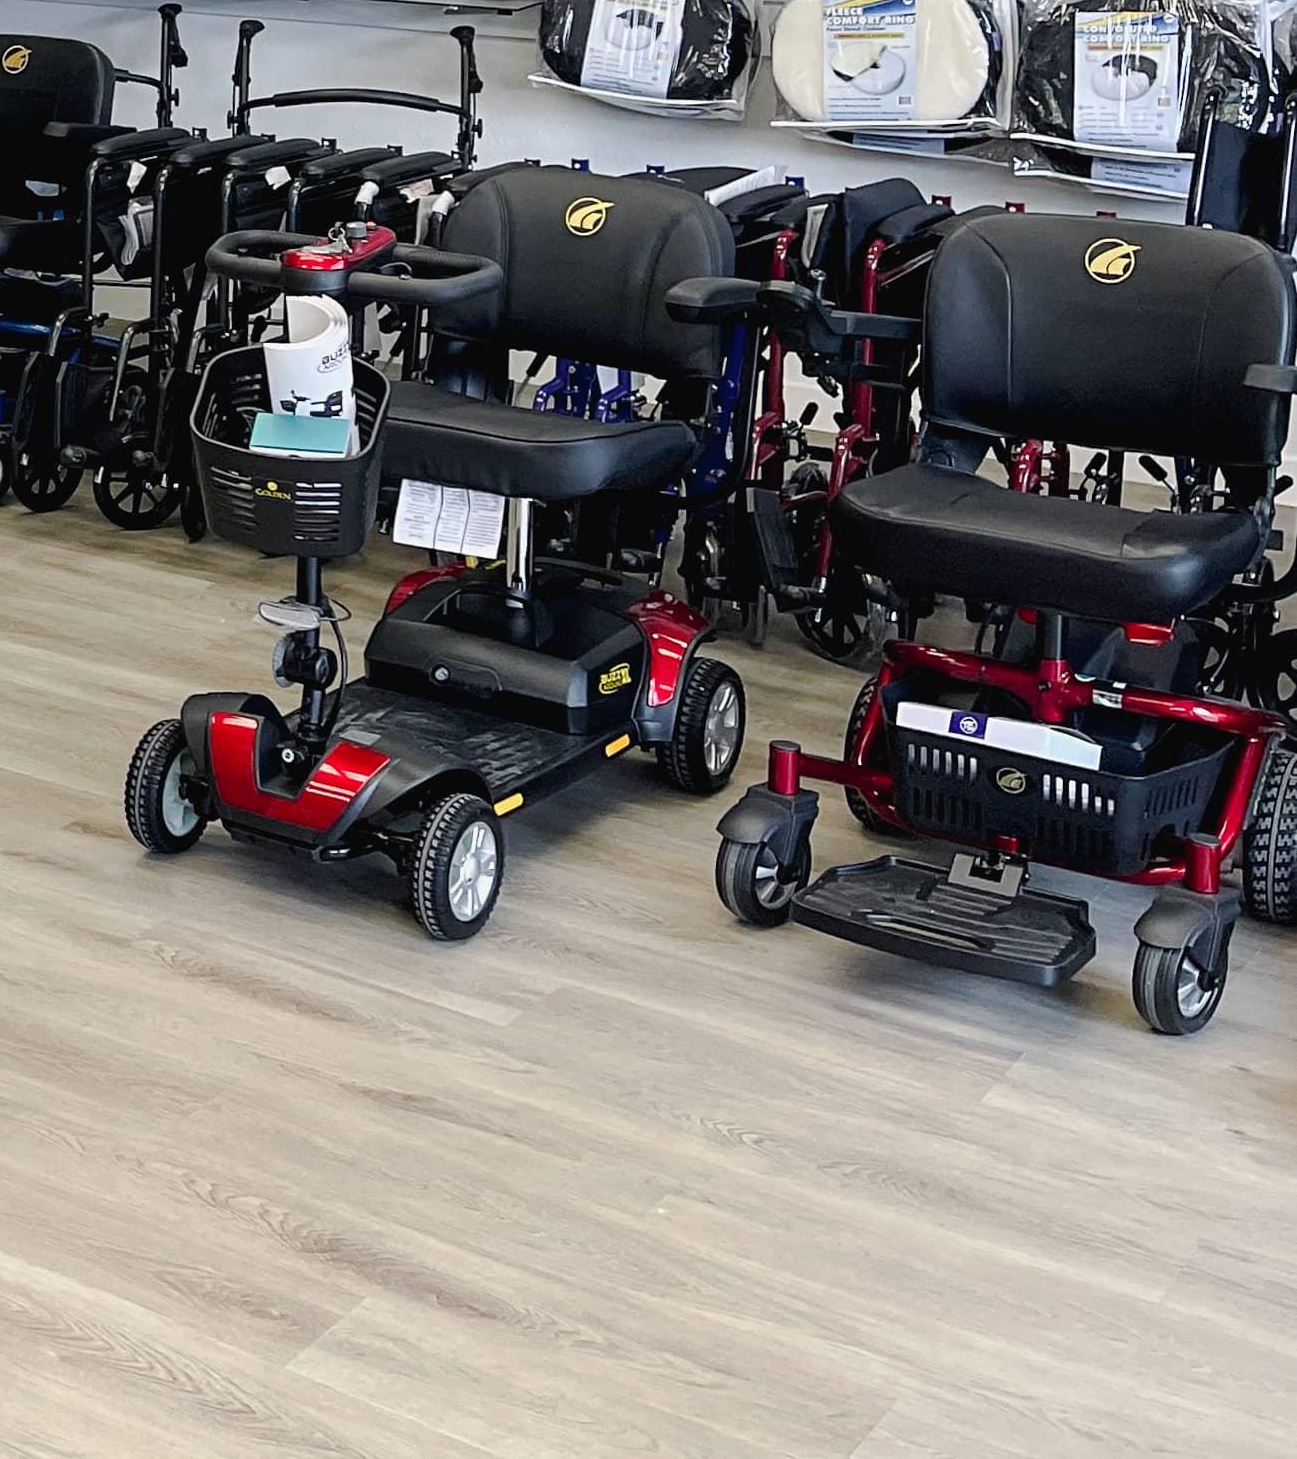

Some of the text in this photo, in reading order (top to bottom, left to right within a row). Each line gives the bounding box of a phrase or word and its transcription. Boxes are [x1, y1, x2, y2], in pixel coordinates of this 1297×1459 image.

[825, 7, 863, 16] FLEECE
[826, 15, 914, 25] COMFORT RING
[255, 487, 292, 501] GOLDEN
